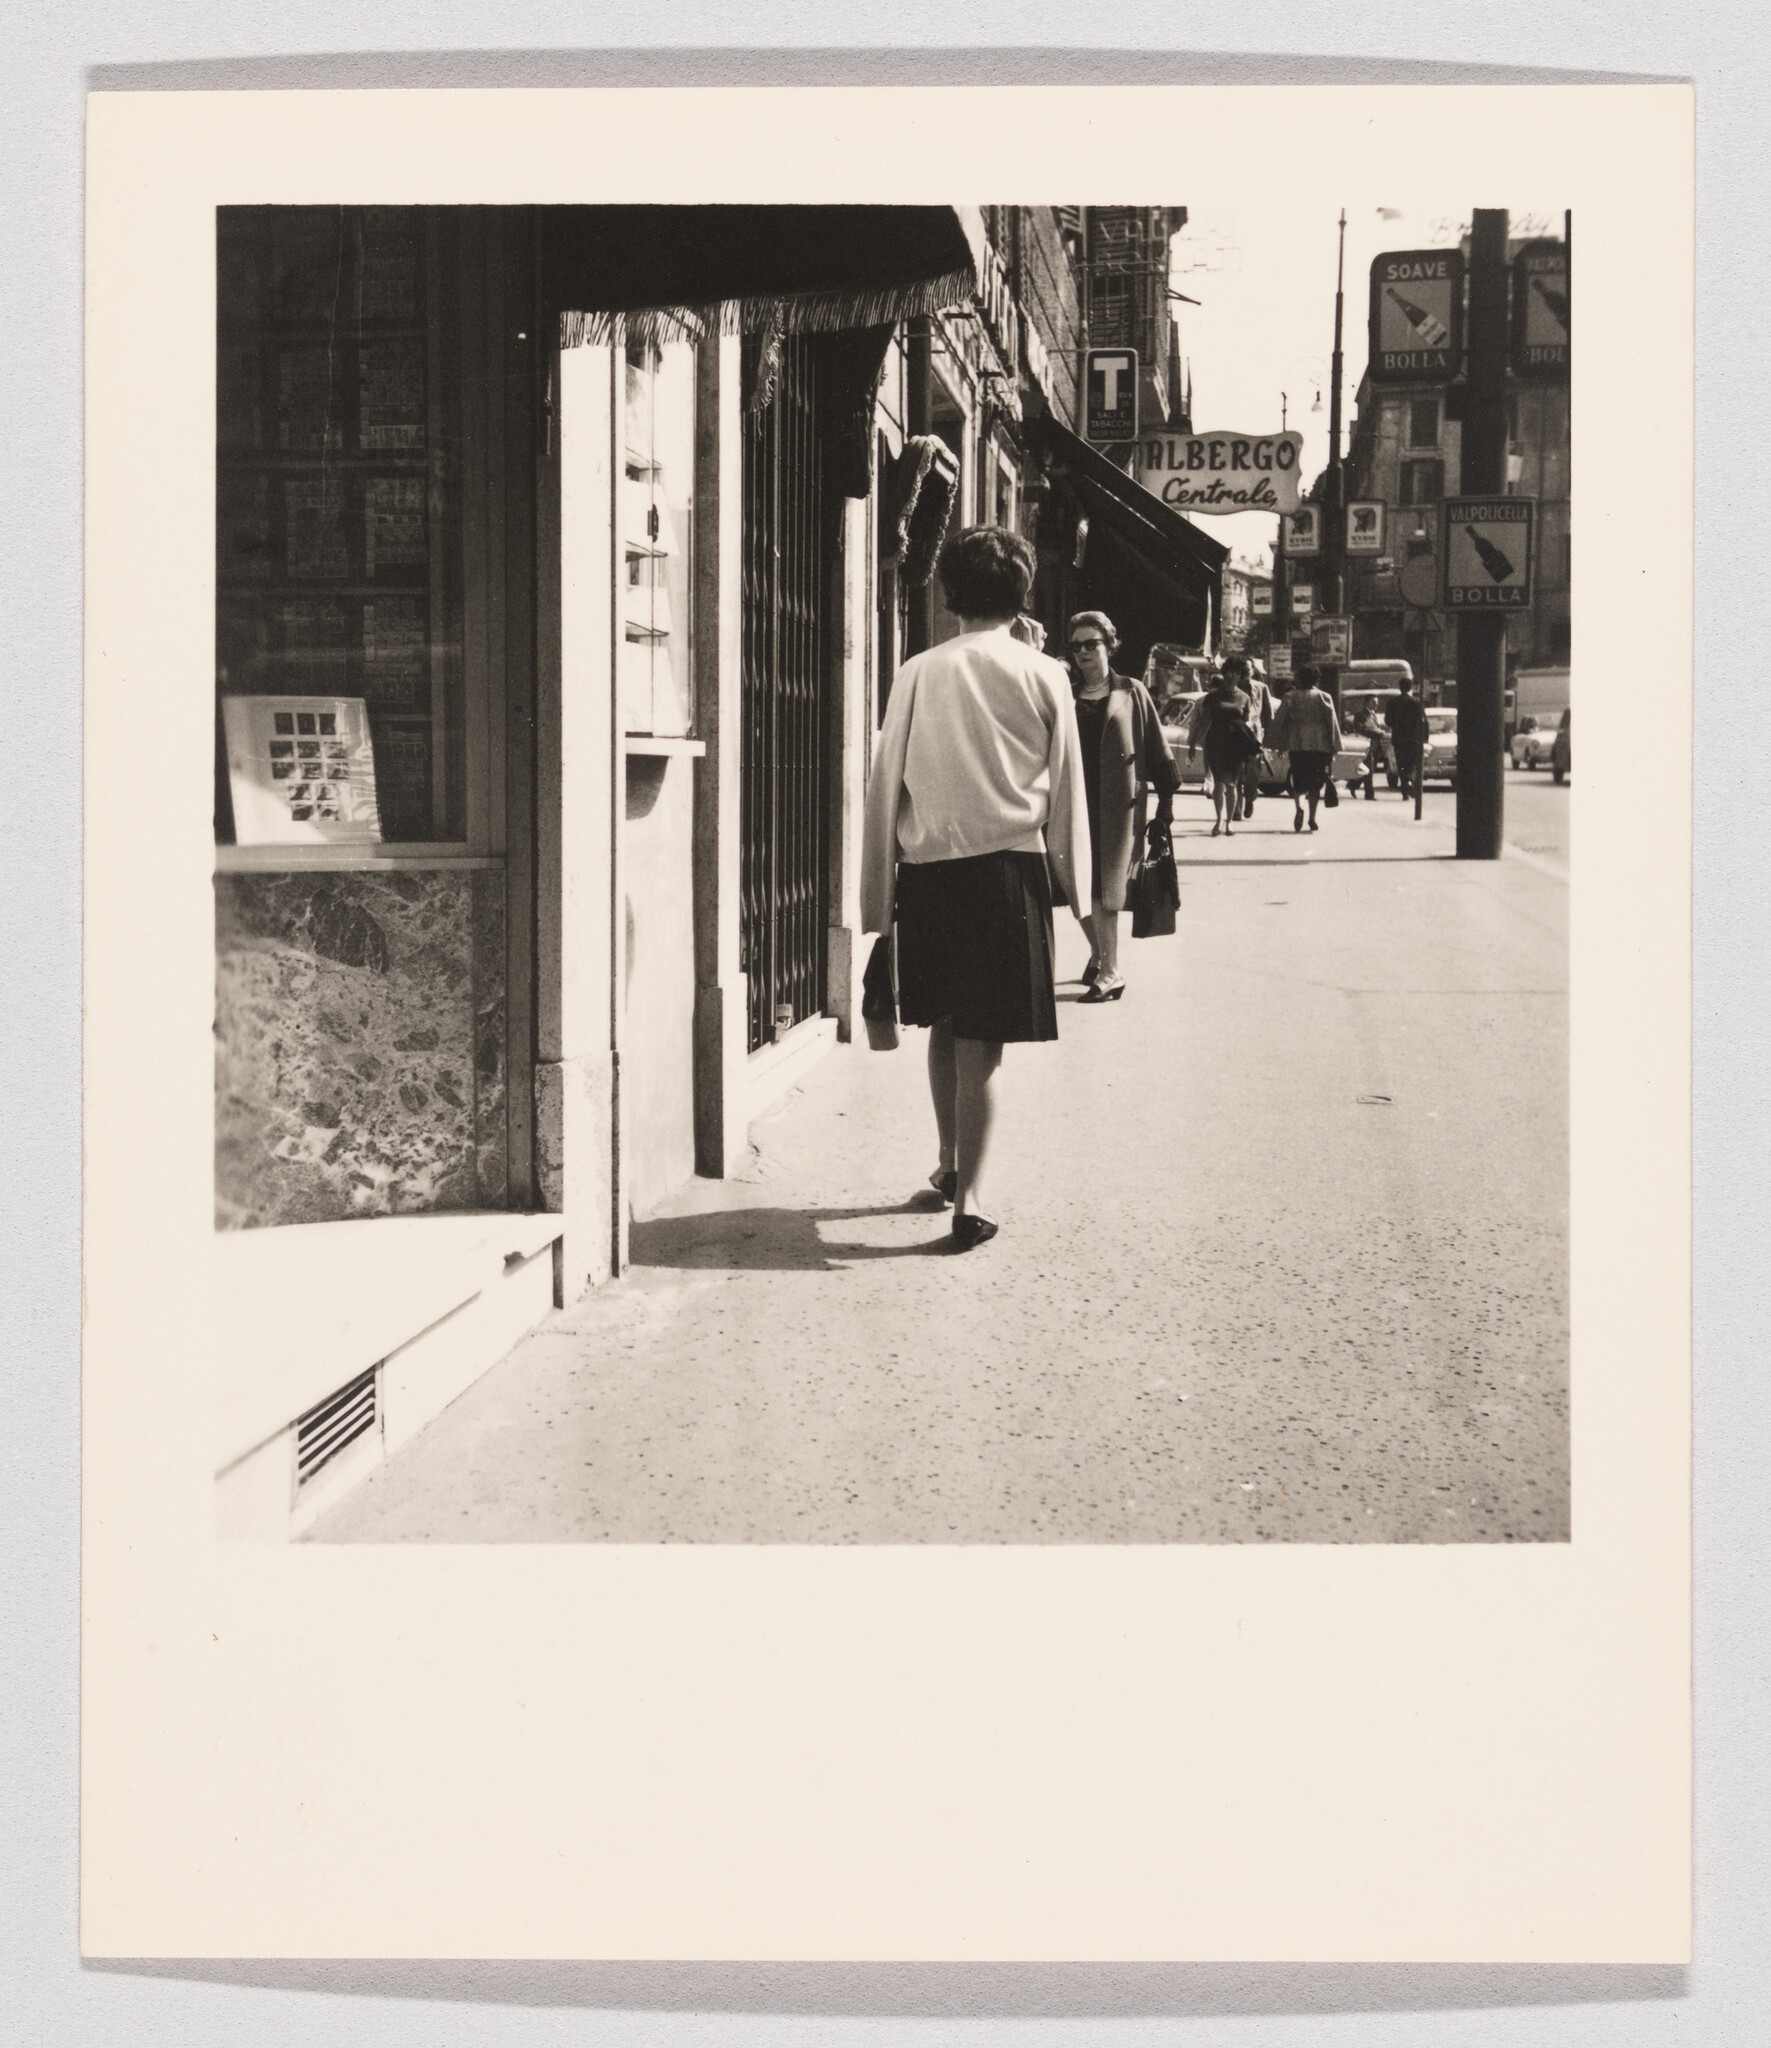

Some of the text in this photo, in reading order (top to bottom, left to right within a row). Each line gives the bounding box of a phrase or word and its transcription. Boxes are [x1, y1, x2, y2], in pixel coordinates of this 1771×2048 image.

[1387, 261, 1448, 280] SOAVE
[1384, 352, 1447, 370] BOLLA
[1093, 357, 1128, 411] T
[1146, 439, 1296, 471] ALBERGO
[1450, 505, 1528, 521] VALPOLICELLA
[1452, 588, 1521, 604] BOLLA
